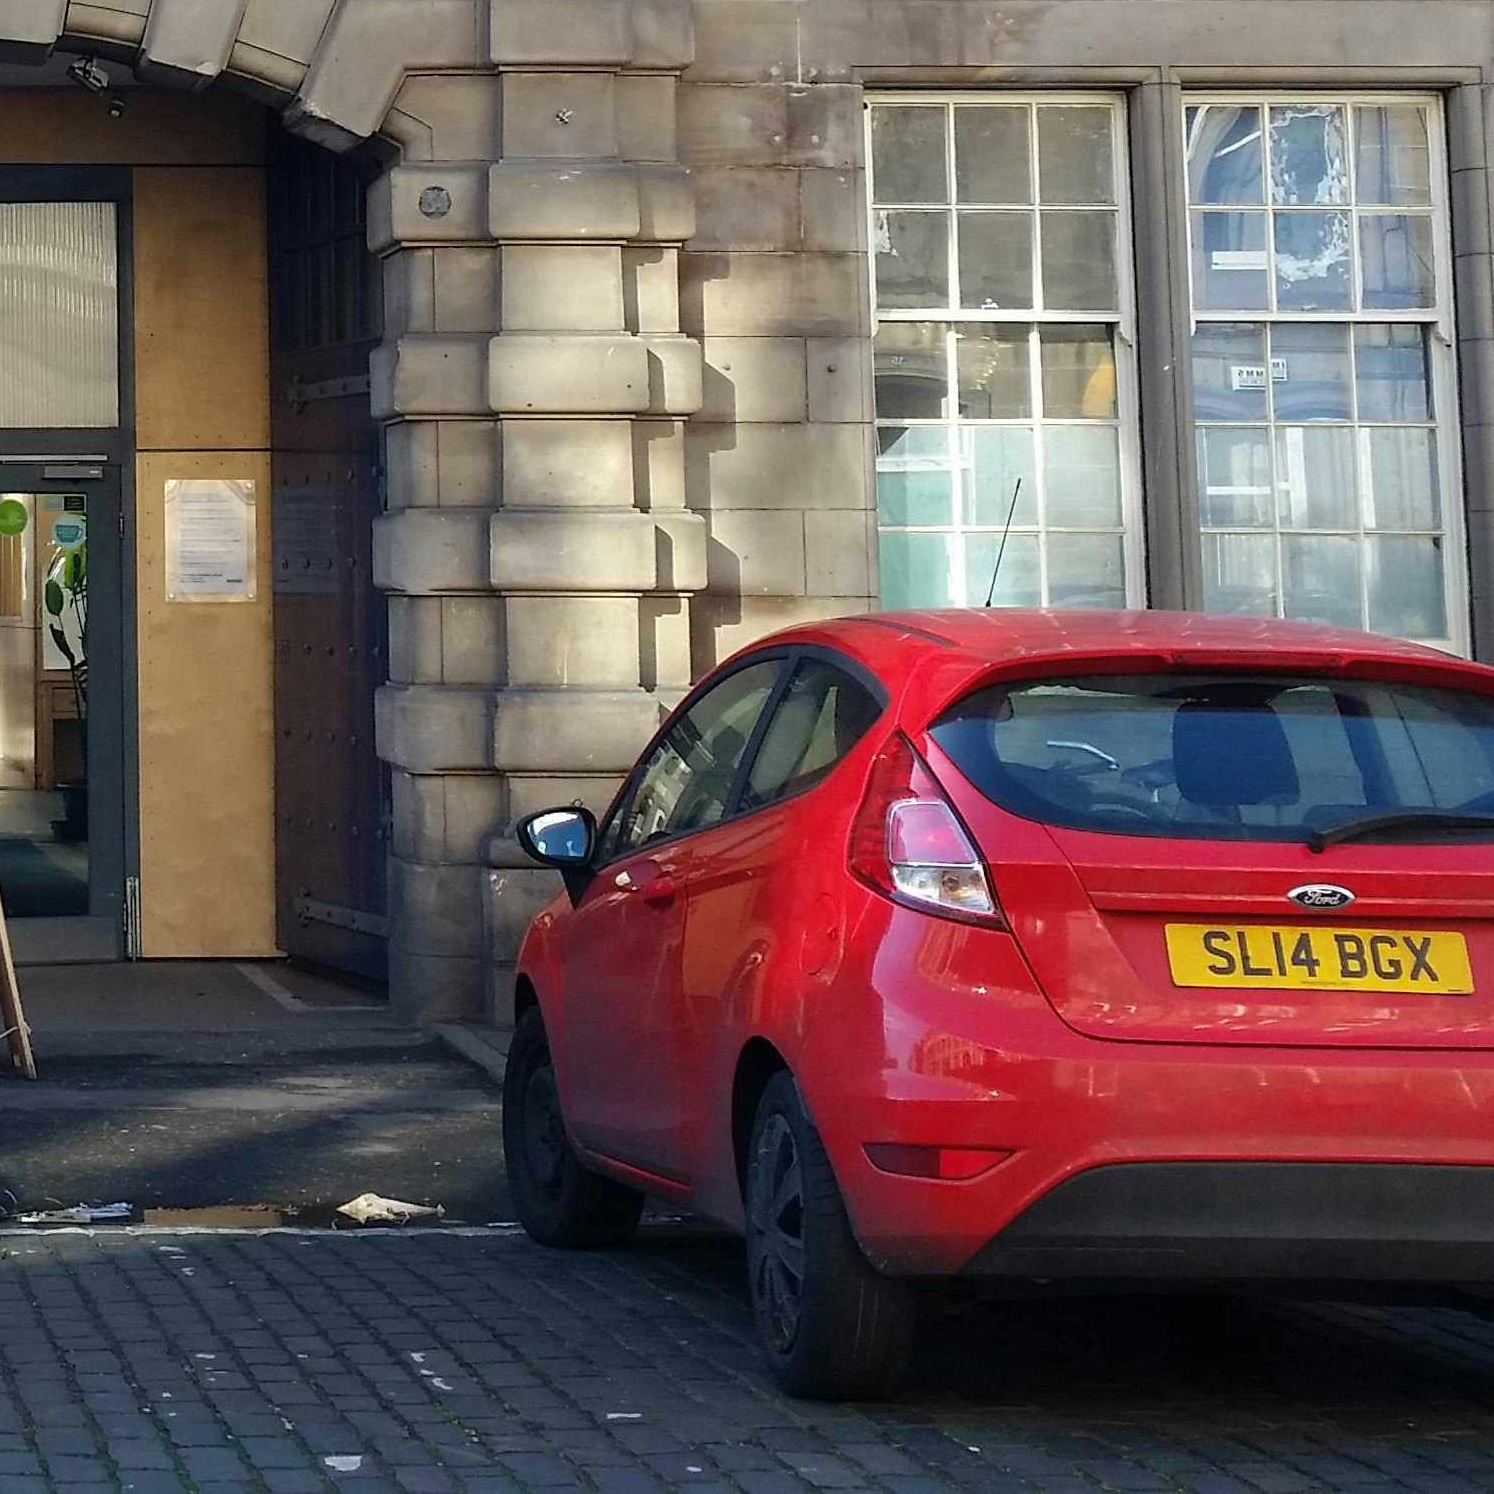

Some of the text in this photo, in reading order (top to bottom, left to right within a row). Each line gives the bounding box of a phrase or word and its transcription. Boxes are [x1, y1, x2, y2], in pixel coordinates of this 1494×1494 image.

[1304, 890, 1342, 904] Ford
[1203, 930, 1439, 982] SL14 BGX
